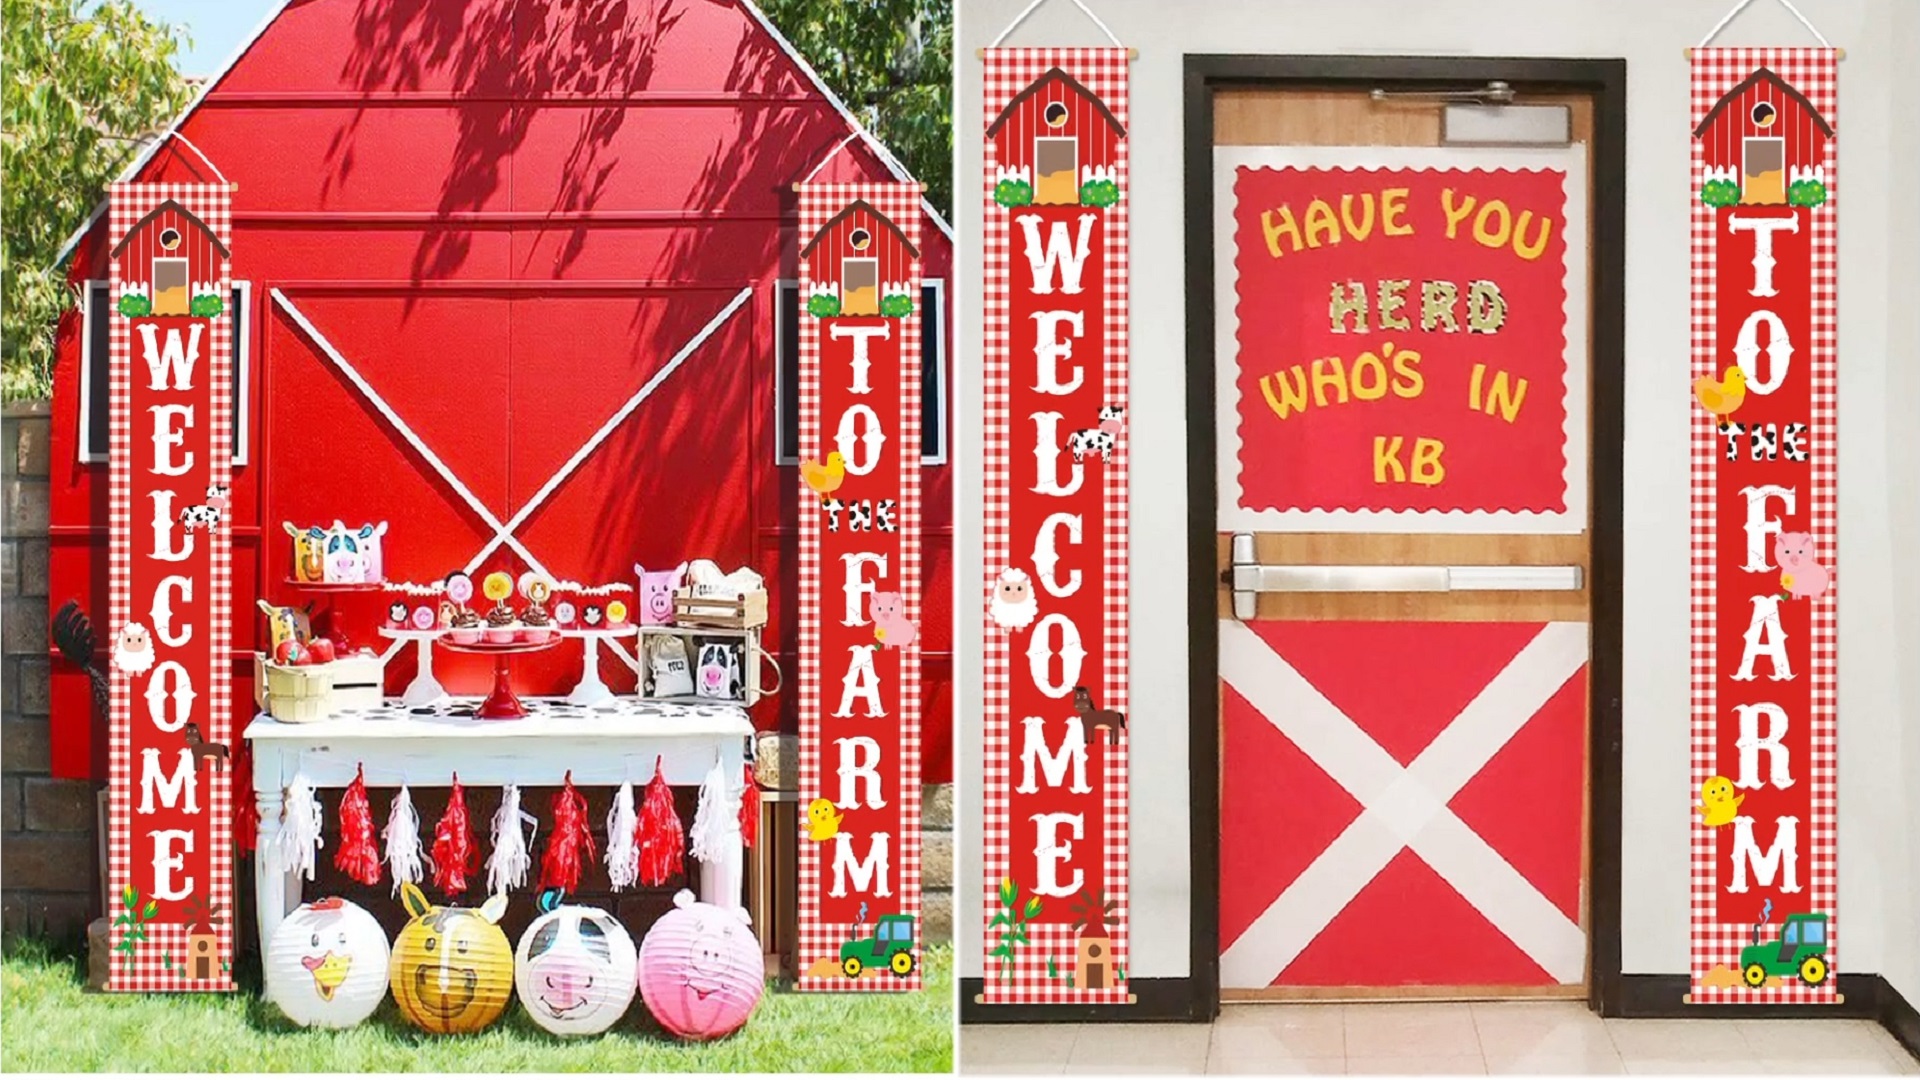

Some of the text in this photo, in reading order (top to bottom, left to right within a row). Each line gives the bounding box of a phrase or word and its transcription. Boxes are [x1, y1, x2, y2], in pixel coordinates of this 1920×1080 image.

[1261, 188, 1551, 260] HAVE YOU
[1329, 280, 1508, 334] HERD
[1728, 212, 1799, 395] TO
[829, 320, 890, 475] TO
[1259, 341, 1528, 423] WHO'S IN
[1373, 436, 1446, 485] KB
[1718, 422, 1810, 462] THE
[822, 499, 898, 533] THE
[1014, 213, 1096, 897] WELCOME
[135, 322, 201, 901] WELCOME
[828, 552, 891, 898] FARM
[1724, 484, 1803, 894] FARM
